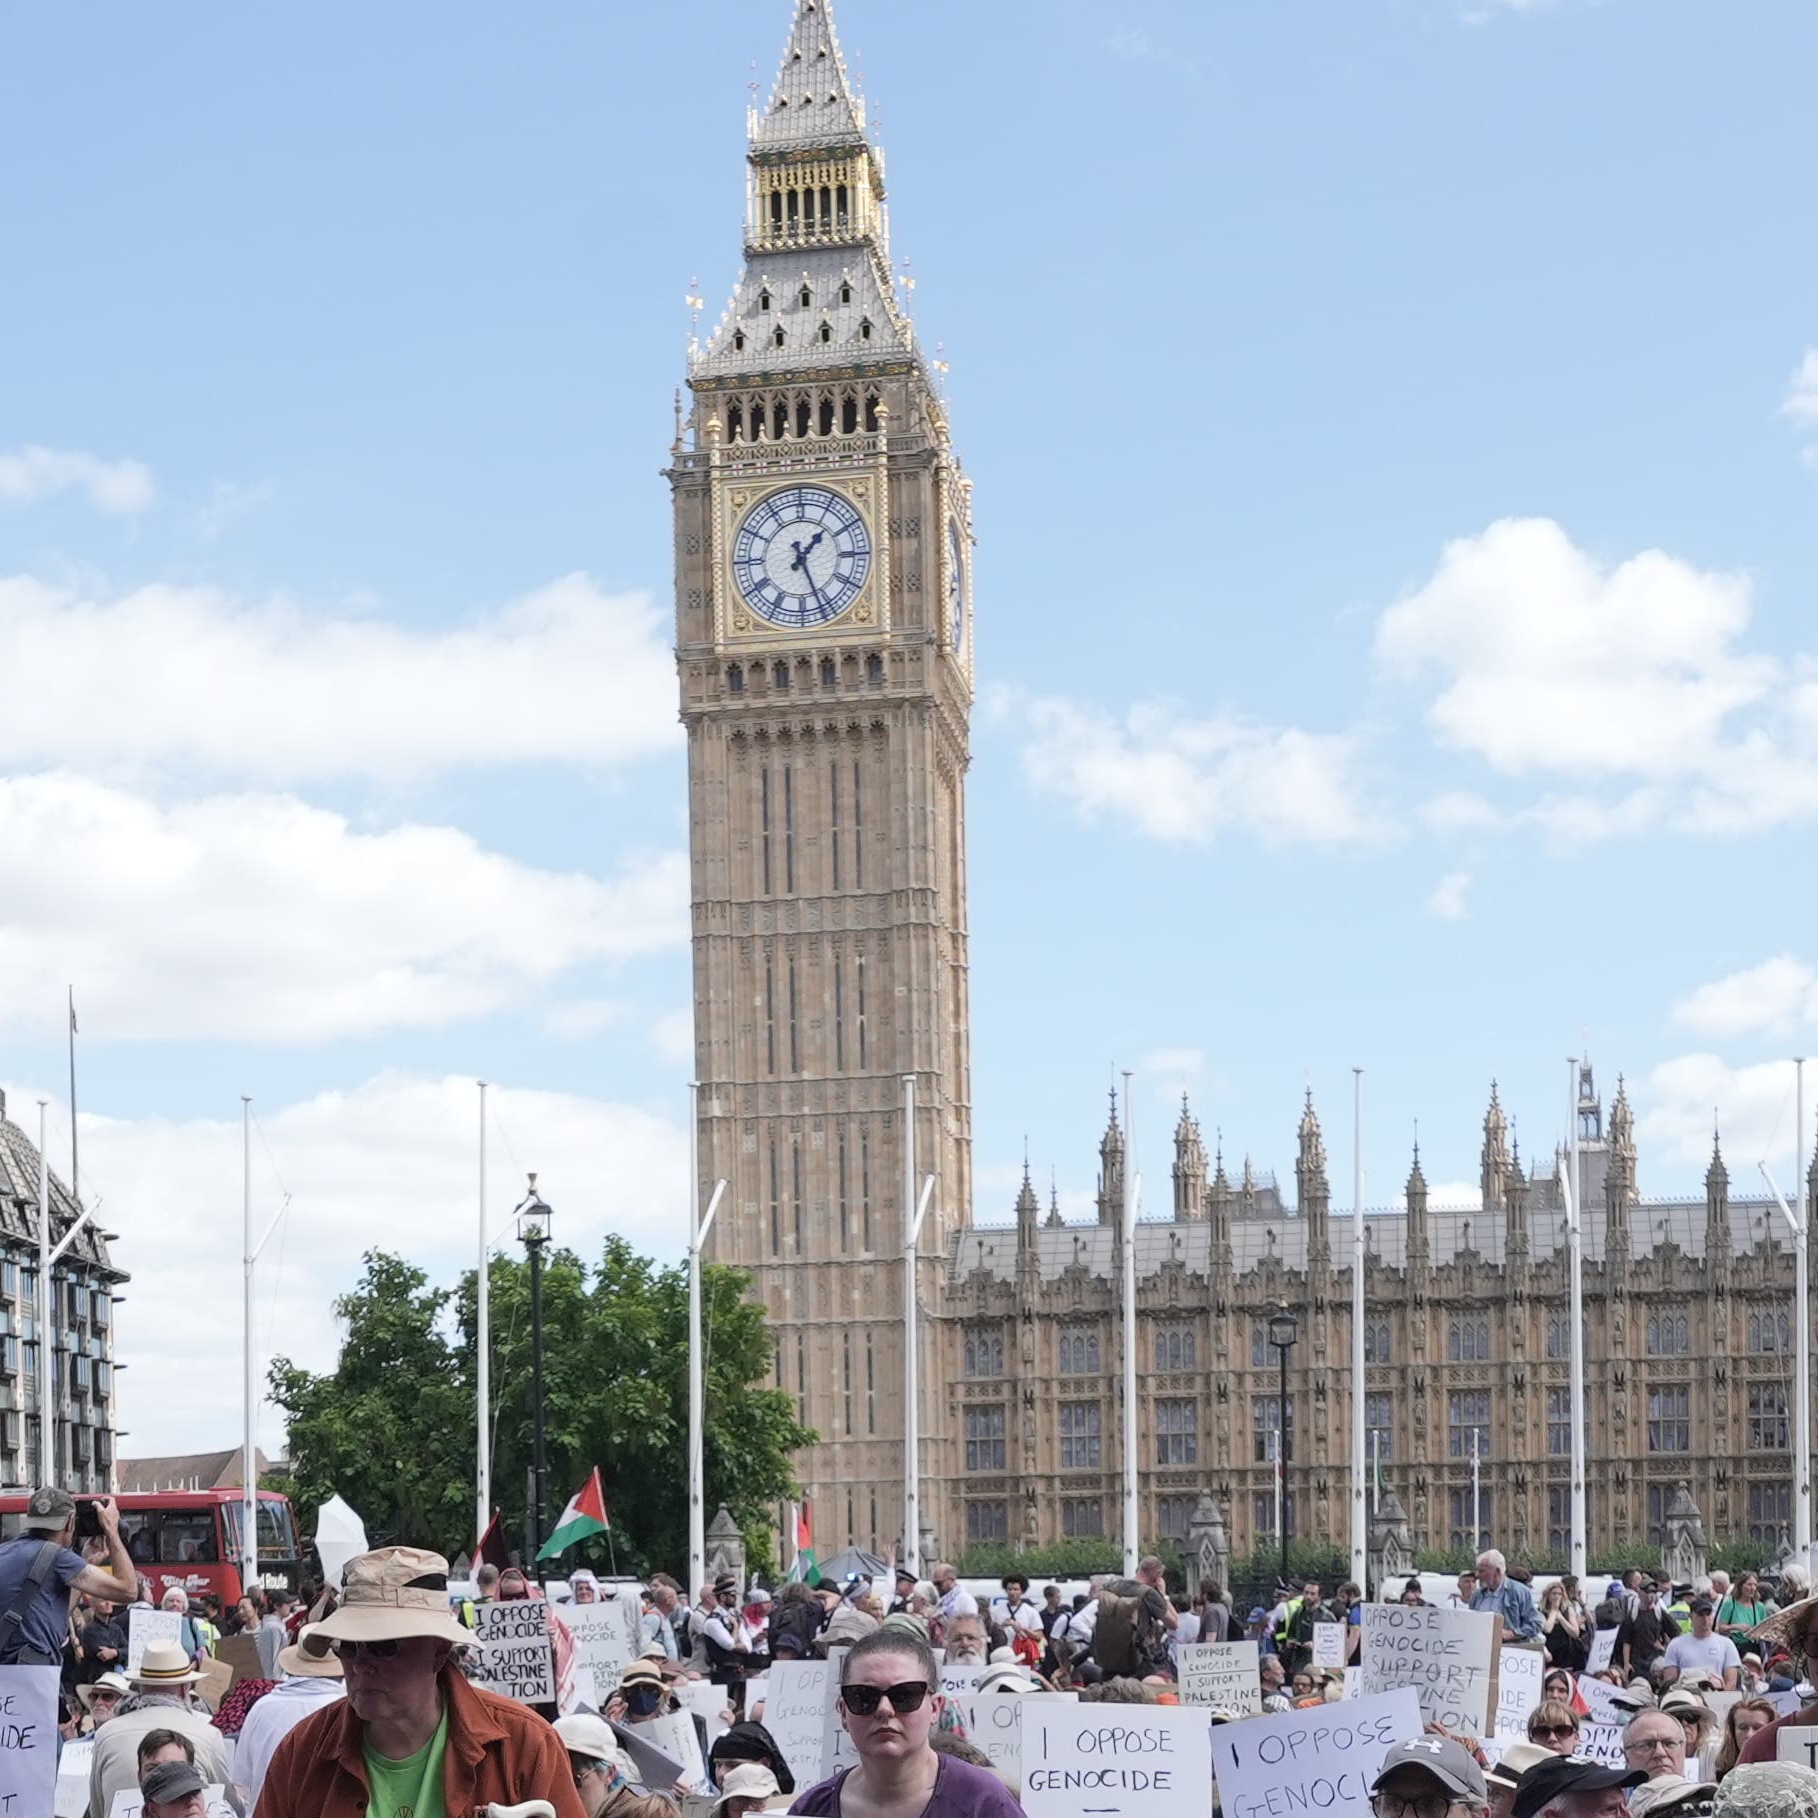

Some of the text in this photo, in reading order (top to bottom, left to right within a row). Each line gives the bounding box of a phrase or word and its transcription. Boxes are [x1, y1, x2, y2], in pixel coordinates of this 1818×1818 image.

[160, 1574, 211, 1588] City Tour
[490, 1604, 548, 1625] OPPOSE
[1365, 1608, 1440, 1631] OPPOSE
[476, 1621, 546, 1642] GENOCIDE
[1368, 1633, 1464, 1656] GENOCIDE
[492, 1646, 549, 1667] SUPPORT
[1184, 1688, 1260, 1703] PALESTINE
[1042, 1726, 1175, 1760] I OPPOSE
[1230, 1714, 1397, 1770] I OPPOSE
[1028, 1769, 1173, 1792] GENOCIDE
